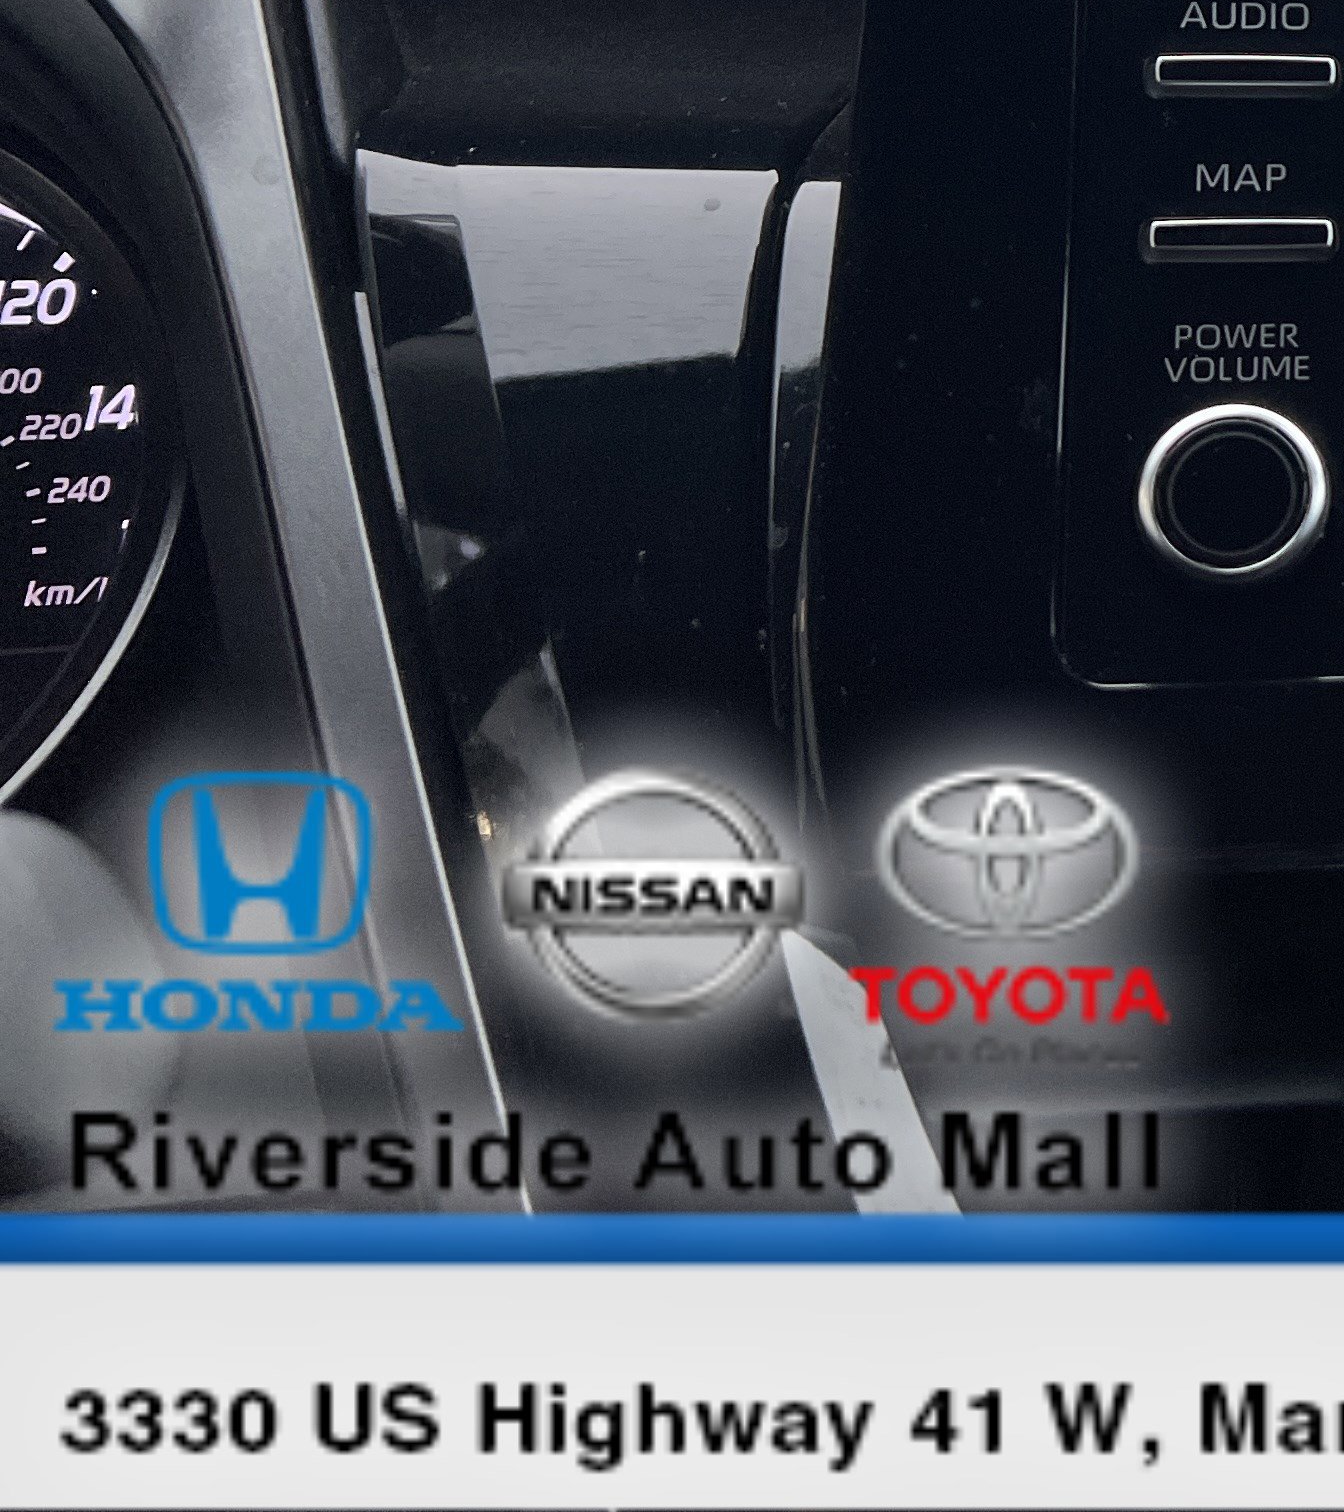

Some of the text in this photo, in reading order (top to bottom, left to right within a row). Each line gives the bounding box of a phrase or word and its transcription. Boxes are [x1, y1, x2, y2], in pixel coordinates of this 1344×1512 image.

[1180, 1, 1310, 31] AUDIO
[1195, 162, 1288, 192] MAP
[1174, 323, 1299, 351] POWER
[1164, 356, 1310, 383] VOLUME
[19, 413, 83, 441] 220
[47, 475, 112, 504] 240
